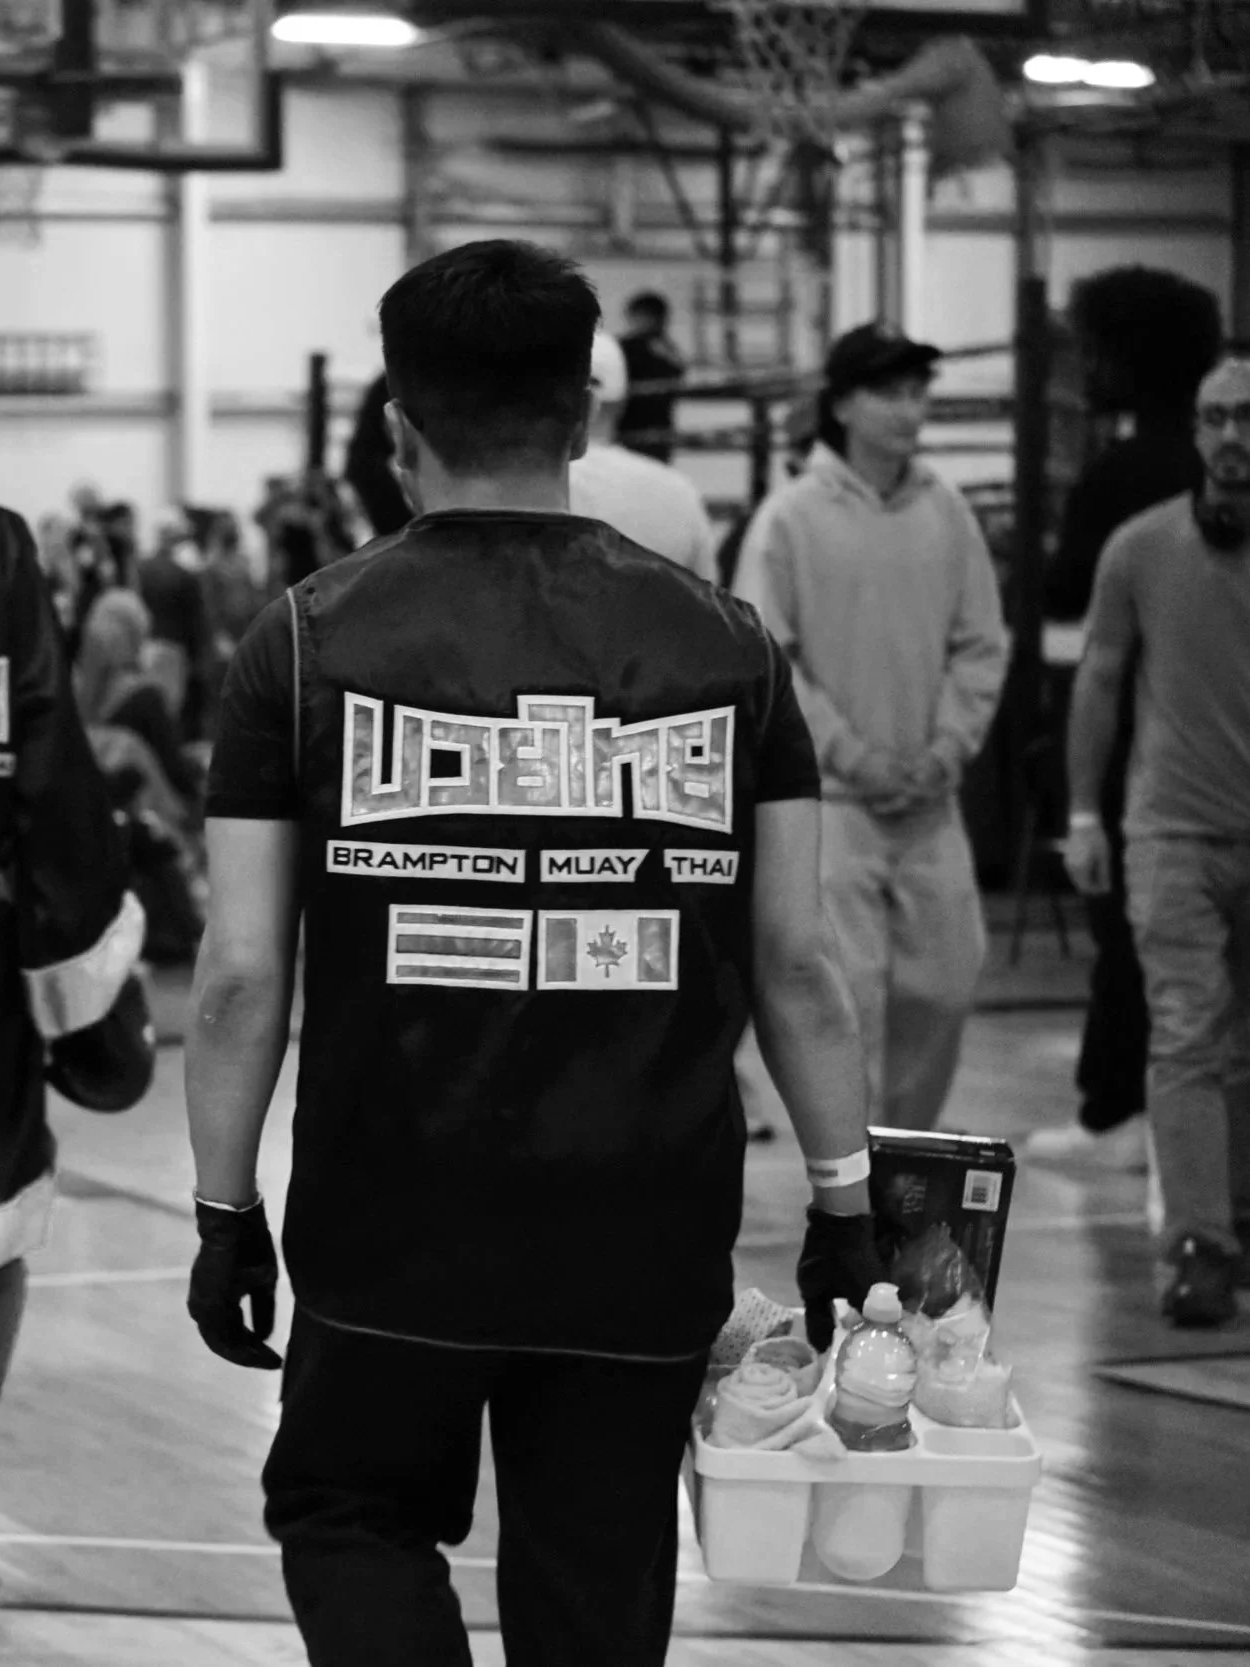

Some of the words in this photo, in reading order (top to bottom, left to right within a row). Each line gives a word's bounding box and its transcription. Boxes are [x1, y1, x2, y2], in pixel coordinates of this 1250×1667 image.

[332, 847, 518, 875] BRAMPTON
[549, 854, 637, 875] MUAY
[671, 856, 733, 877] THAI
